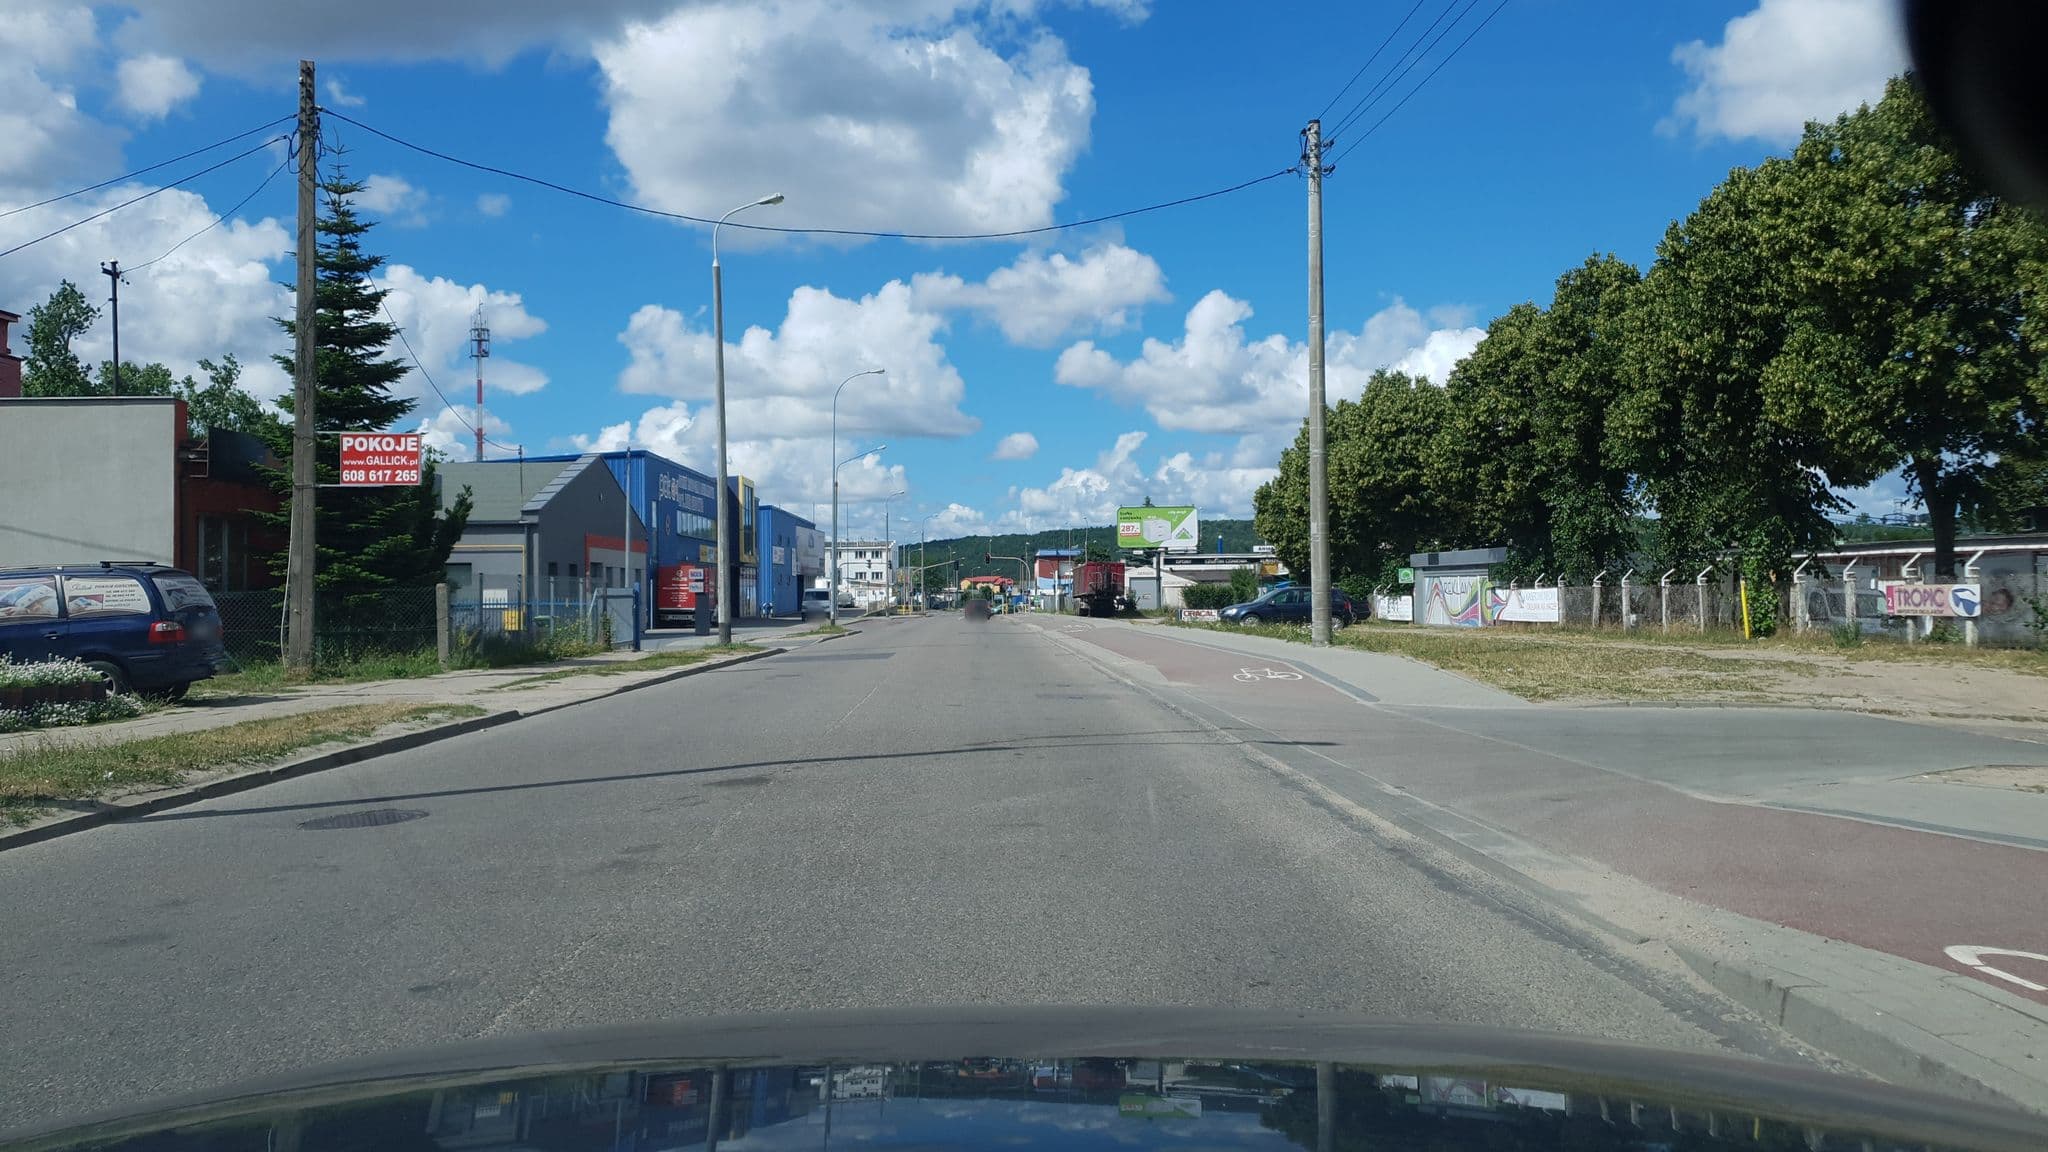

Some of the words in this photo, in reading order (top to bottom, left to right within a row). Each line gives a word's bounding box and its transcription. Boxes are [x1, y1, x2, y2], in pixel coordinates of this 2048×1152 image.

[342, 437, 418, 452] POKOJE
[342, 455, 418, 467] www.GALLICK.pl
[342, 470, 365, 482] 608
[369, 470, 391, 482] 617
[395, 470, 418, 482] 265
[1895, 587, 1945, 607] TROPIC
